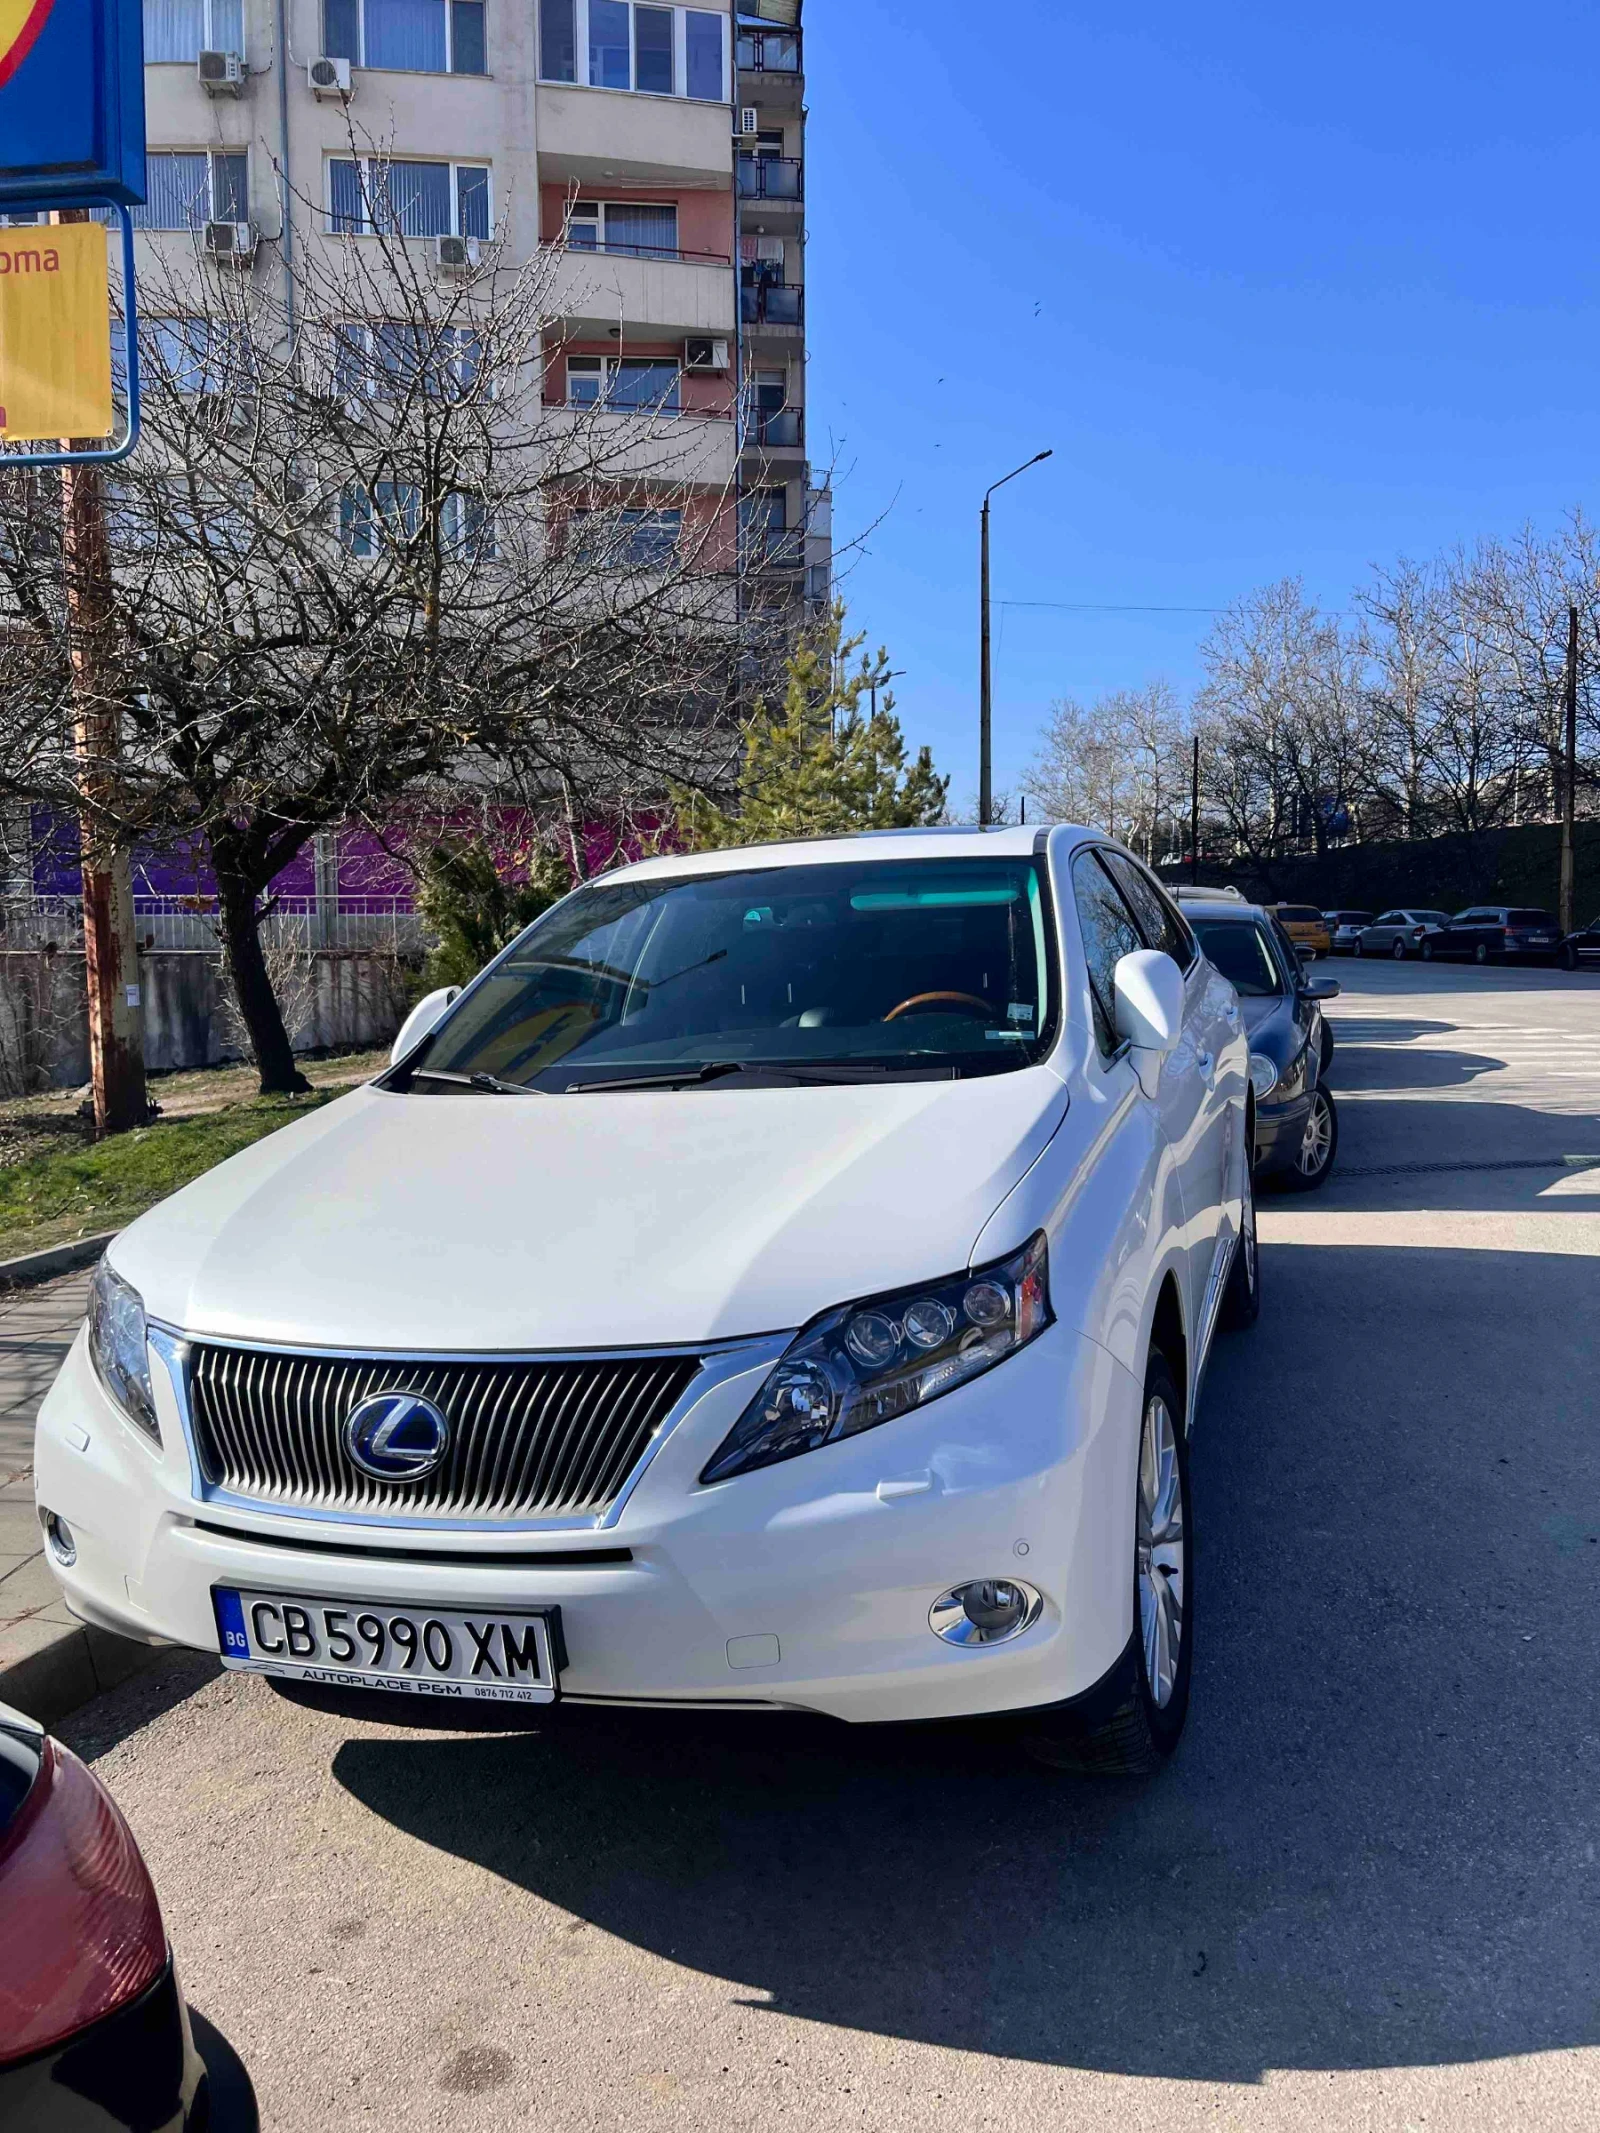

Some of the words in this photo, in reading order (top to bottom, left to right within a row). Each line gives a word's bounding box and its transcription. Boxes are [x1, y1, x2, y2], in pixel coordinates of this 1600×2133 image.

[225, 1630, 246, 1648] BG
[251, 1600, 317, 1657] CB
[322, 1607, 454, 1672] 5990
[464, 1621, 541, 1680] XM
[302, 1670, 413, 1692] AUTOPLACE
[475, 1687, 498, 1699] 0876
[499, 1689, 515, 1700] 712
[516, 1690, 533, 1701] 412
